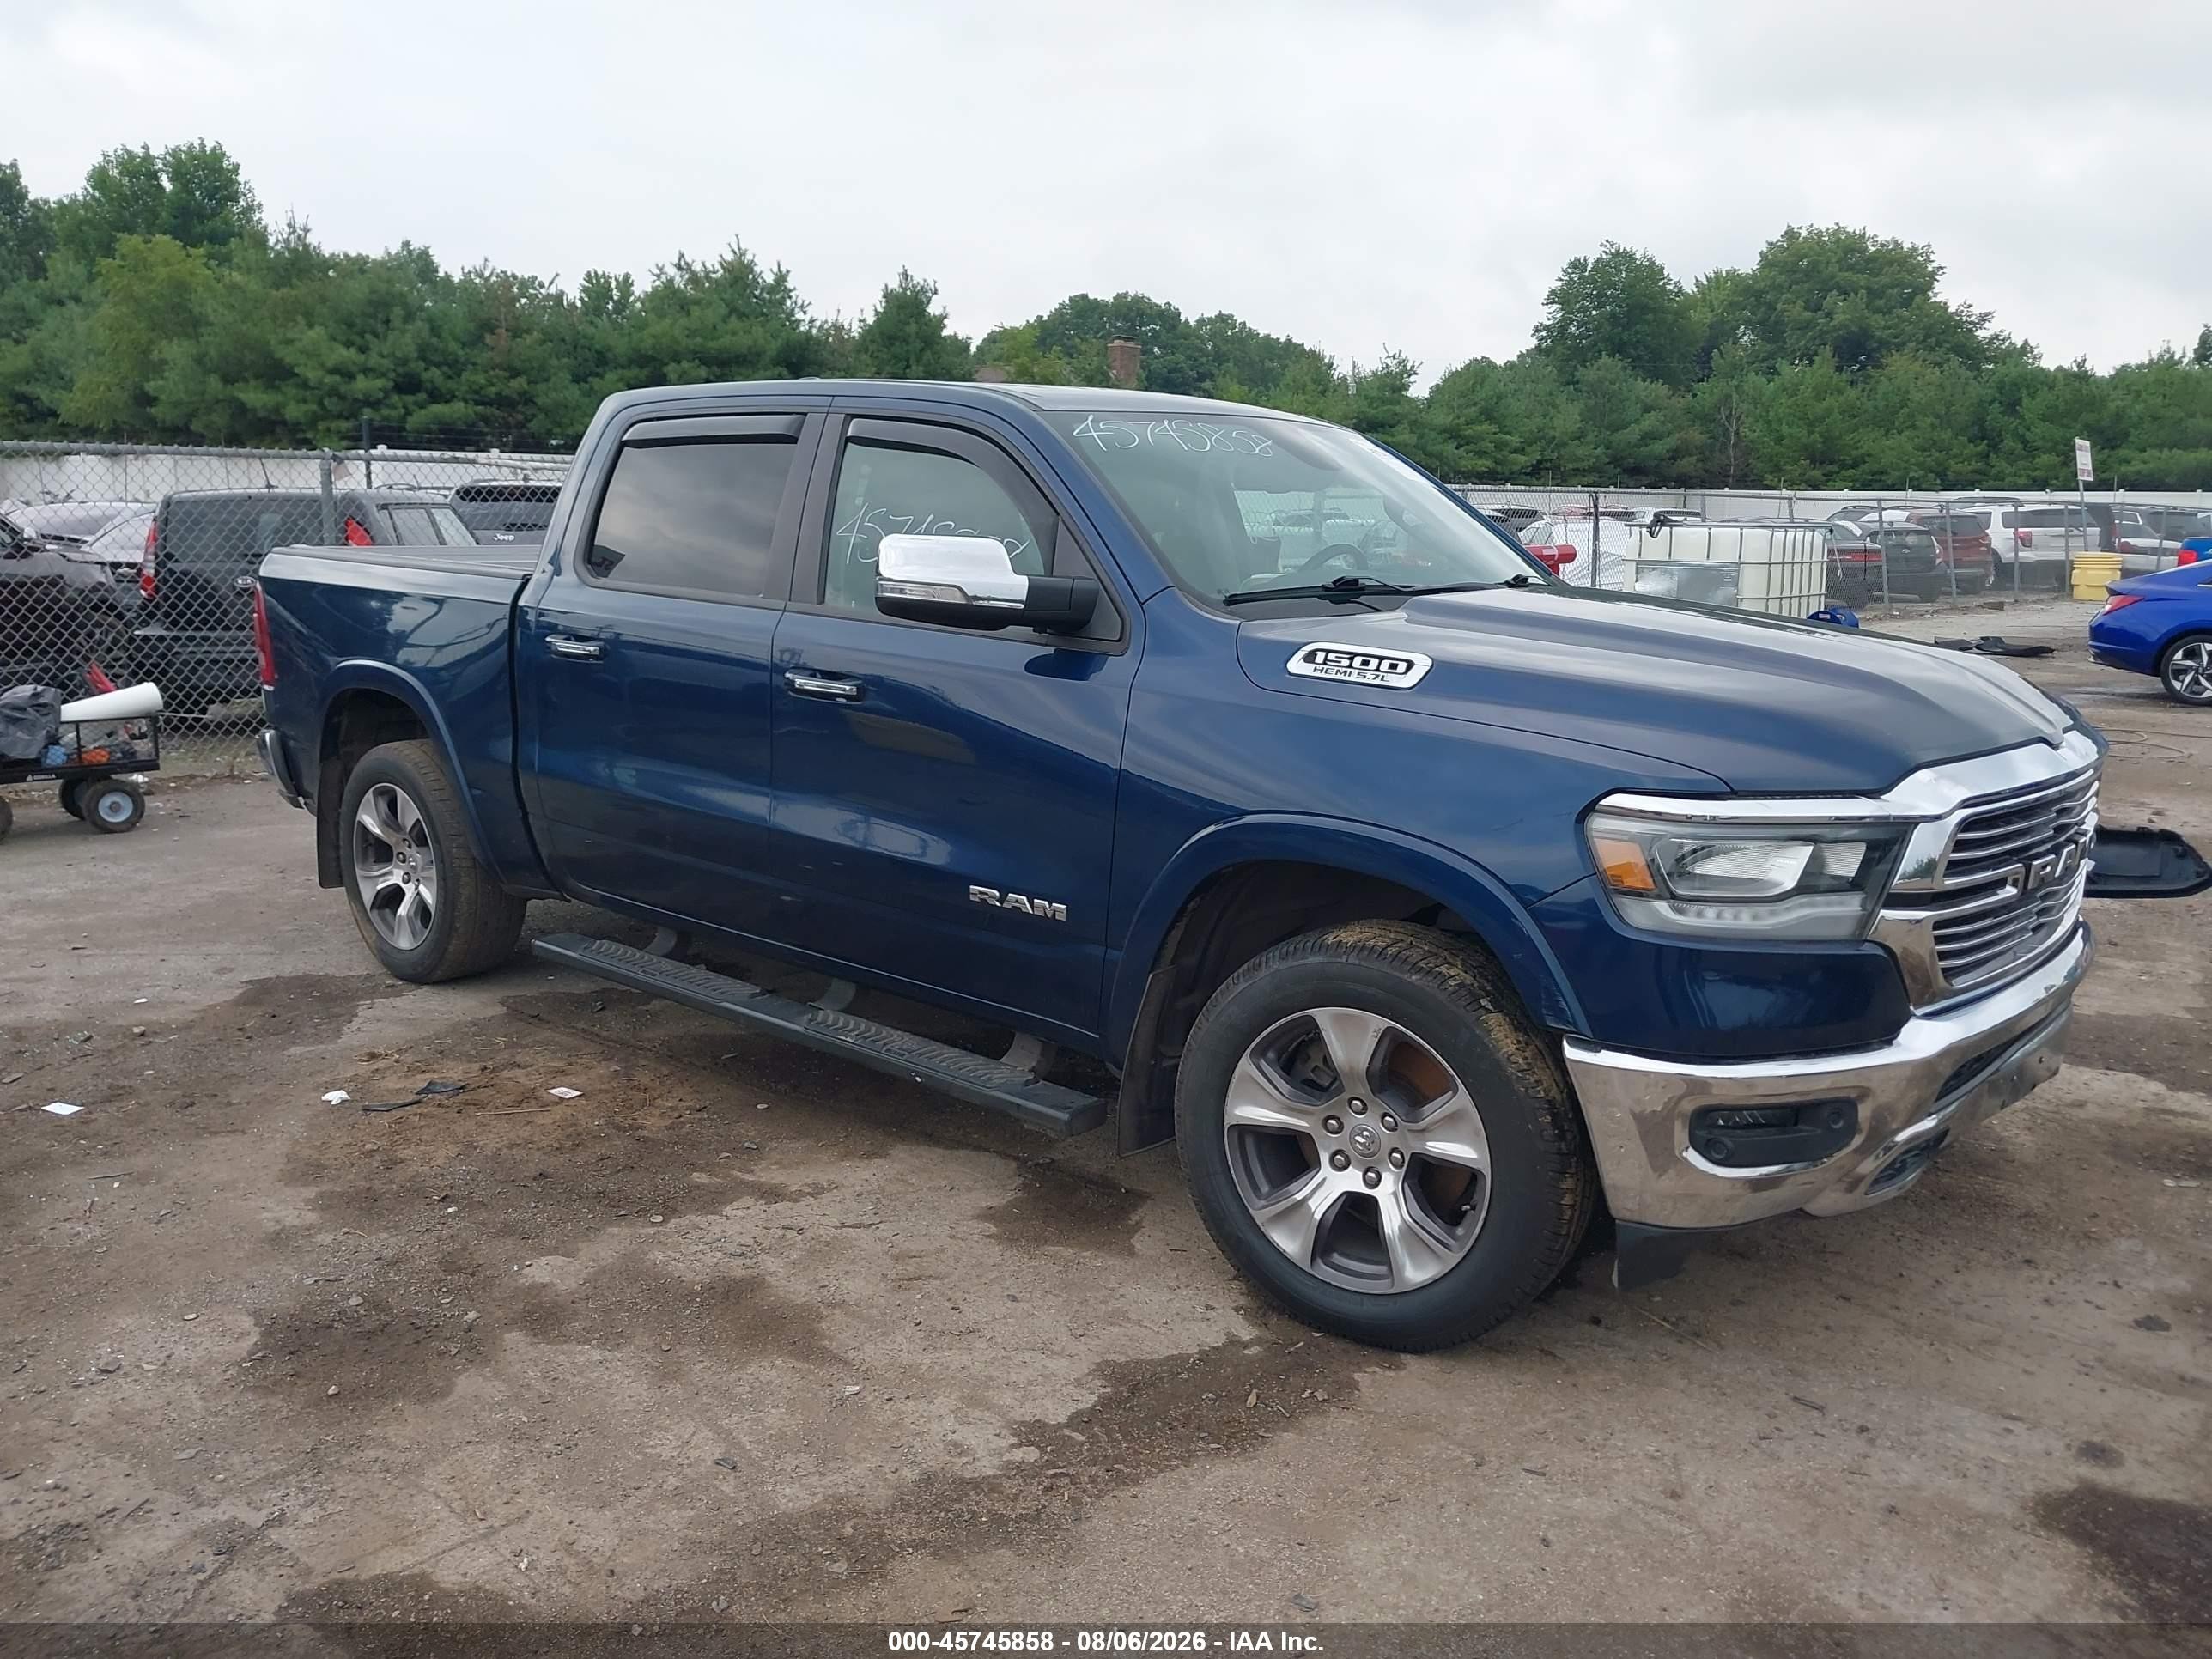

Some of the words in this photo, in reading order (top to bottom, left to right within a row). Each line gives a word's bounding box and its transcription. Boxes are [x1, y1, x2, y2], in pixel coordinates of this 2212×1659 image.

[1073, 414, 1273, 457] 45745858
[1313, 665, 1352, 678] HEMI
[1356, 672, 1390, 683] 5.7L
[1314, 651, 1409, 675] 1500
[969, 885, 1067, 921] RAM
